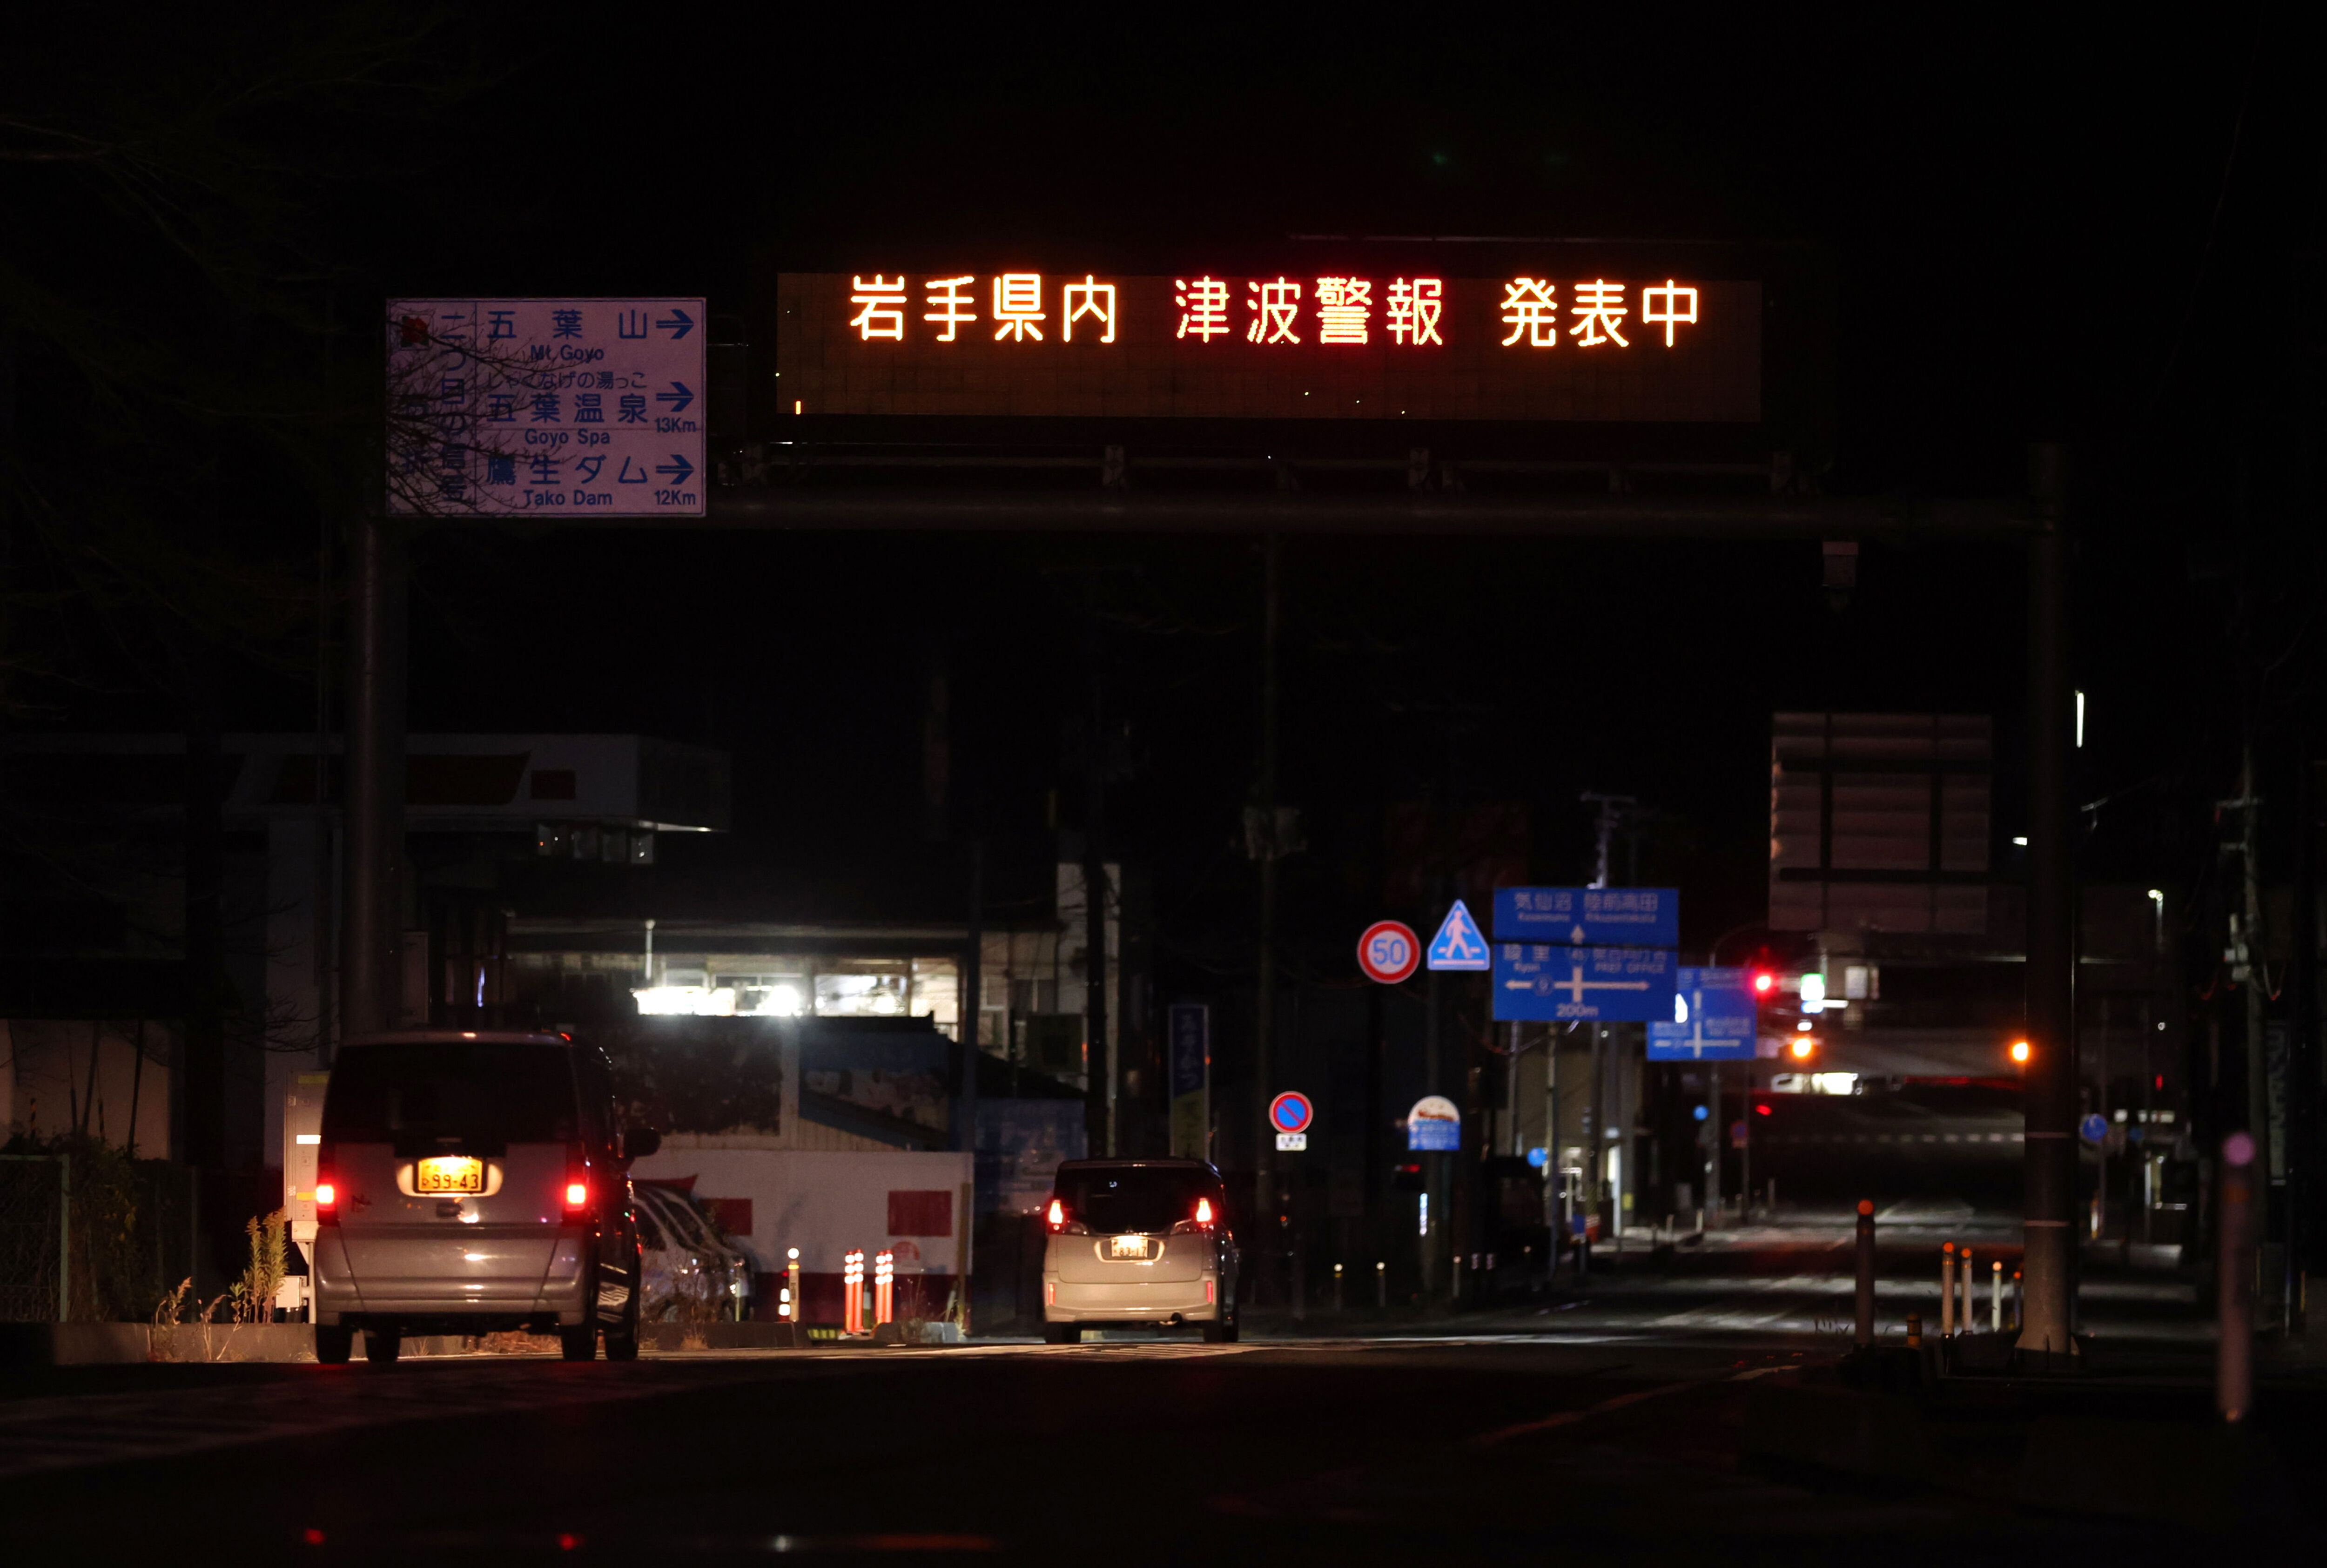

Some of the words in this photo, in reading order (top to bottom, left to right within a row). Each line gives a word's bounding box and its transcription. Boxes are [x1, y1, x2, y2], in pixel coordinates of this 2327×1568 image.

[850, 274, 1115, 343] 岩手県内
[1176, 276, 1442, 345] 津波警報
[1500, 278, 1697, 348] 発表中
[487, 310, 647, 339] 五葉山
[560, 345, 604, 363] Goyo
[487, 393, 647, 423] 五葉温泉
[656, 418, 696, 433] 13Km
[525, 429, 569, 447] Goyo
[578, 429, 610, 447] Spa
[486, 455, 648, 485] 鷹生ダム
[524, 490, 565, 505] Tako
[574, 490, 612, 505] Dam
[654, 490, 695, 505] 12Km
[1373, 939, 1406, 965] 50
[1556, 1003, 1599, 1017] 200m
[432, 1174, 478, 1189] 99-43
